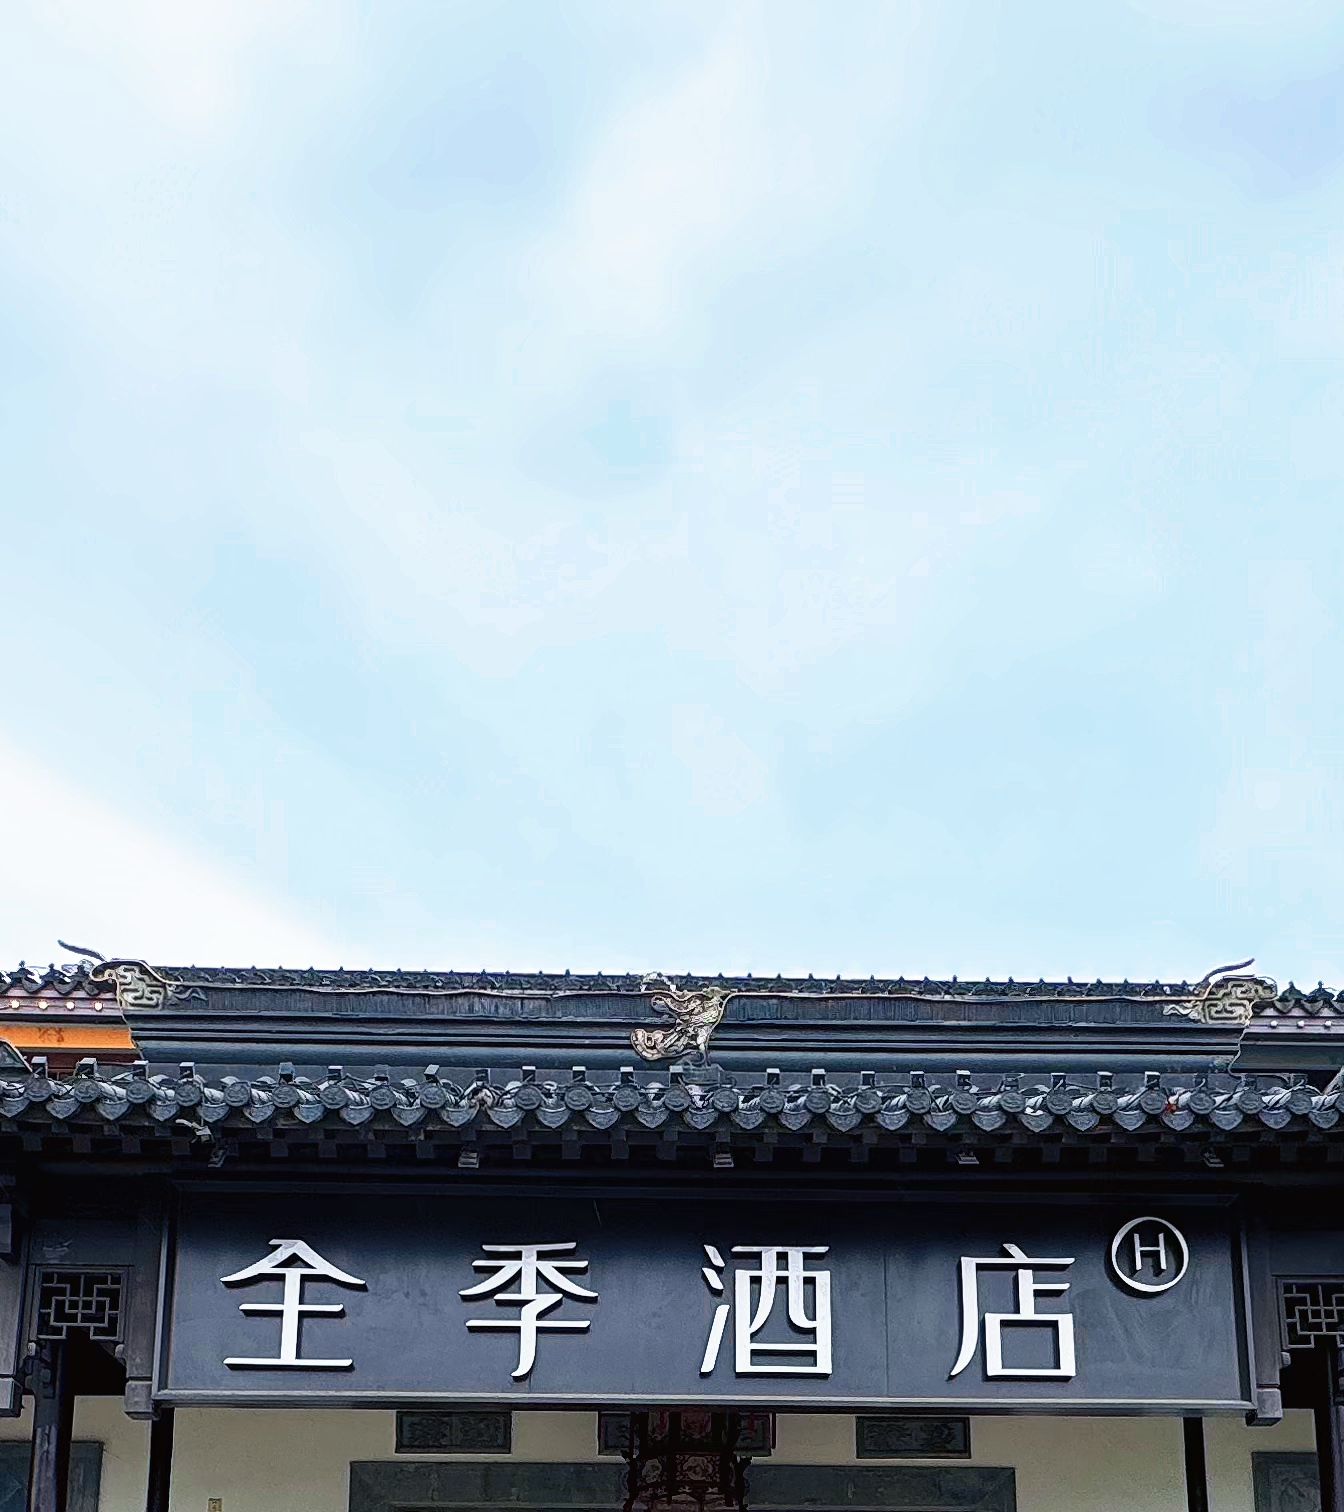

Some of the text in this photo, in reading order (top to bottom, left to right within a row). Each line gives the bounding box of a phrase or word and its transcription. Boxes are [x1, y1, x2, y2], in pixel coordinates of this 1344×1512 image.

[1133, 1232, 1167, 1271] H
[220, 1238, 1078, 1378] 全季酒店
